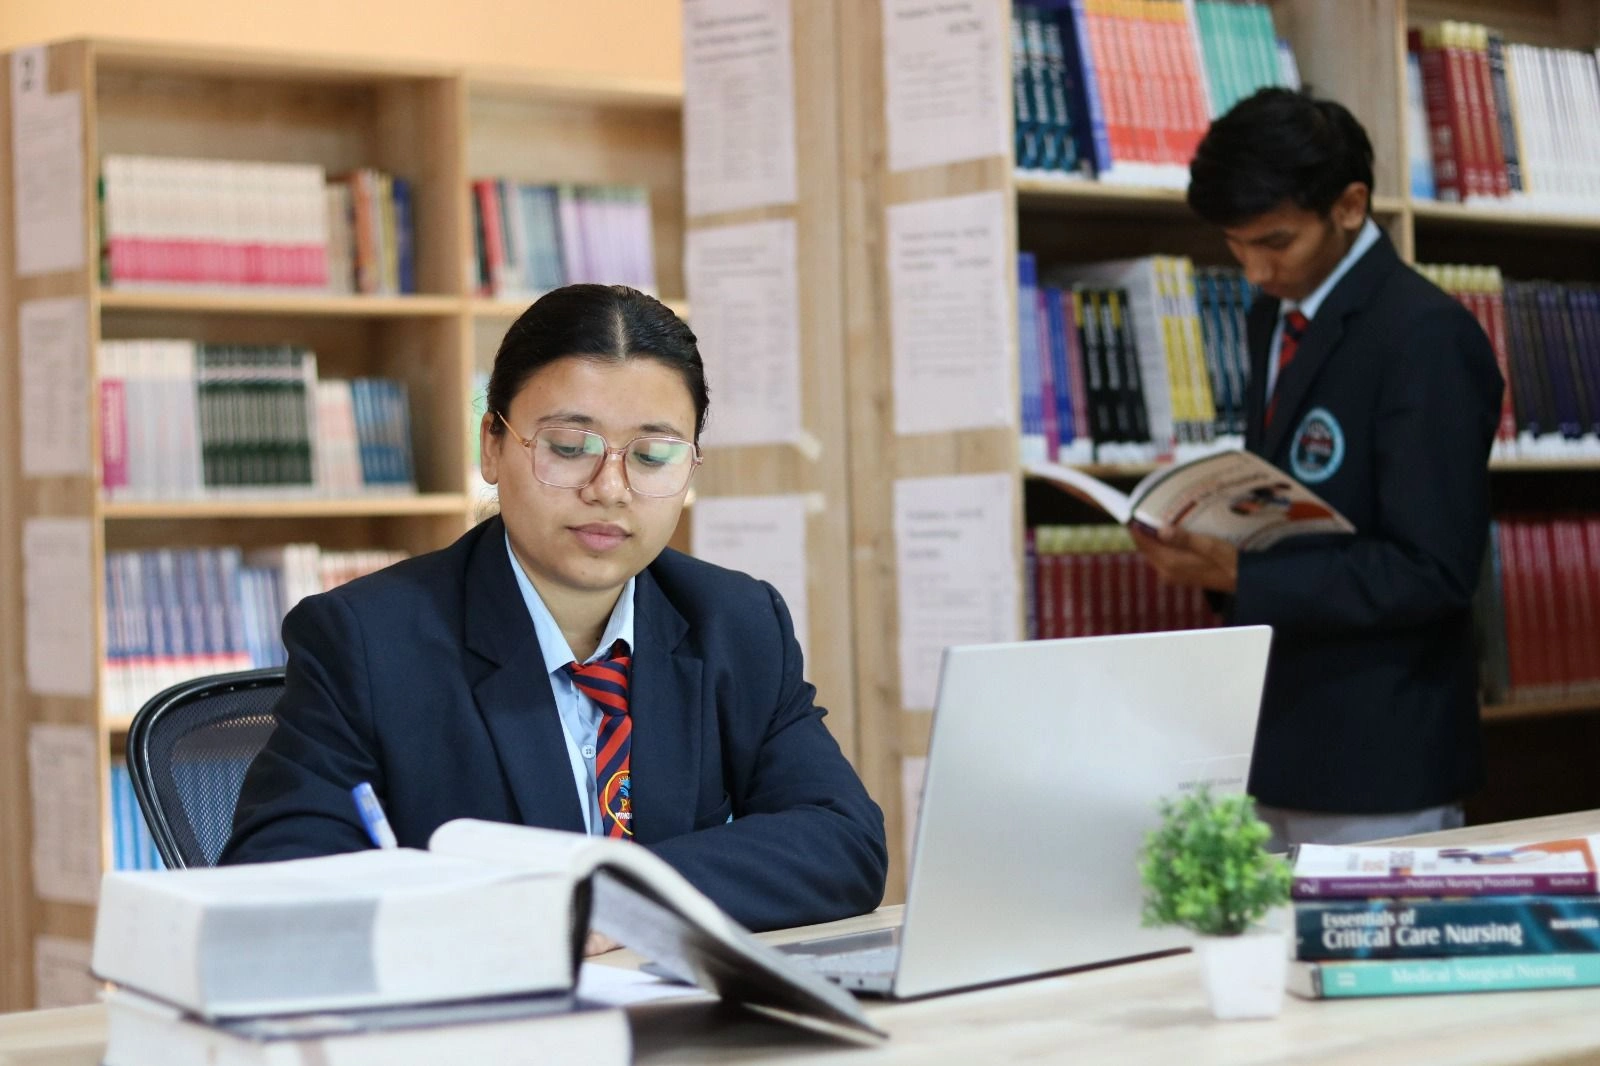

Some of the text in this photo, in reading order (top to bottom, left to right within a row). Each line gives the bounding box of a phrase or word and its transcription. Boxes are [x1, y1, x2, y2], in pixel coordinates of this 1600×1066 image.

[1447, 877, 1482, 890] Nursing
[1484, 877, 1534, 888] Procedures
[1322, 908, 1416, 929] Essentials of
[1322, 922, 1523, 950] Critical Care Nursing
[1391, 961, 1576, 985] Medical Surgical Nursing
